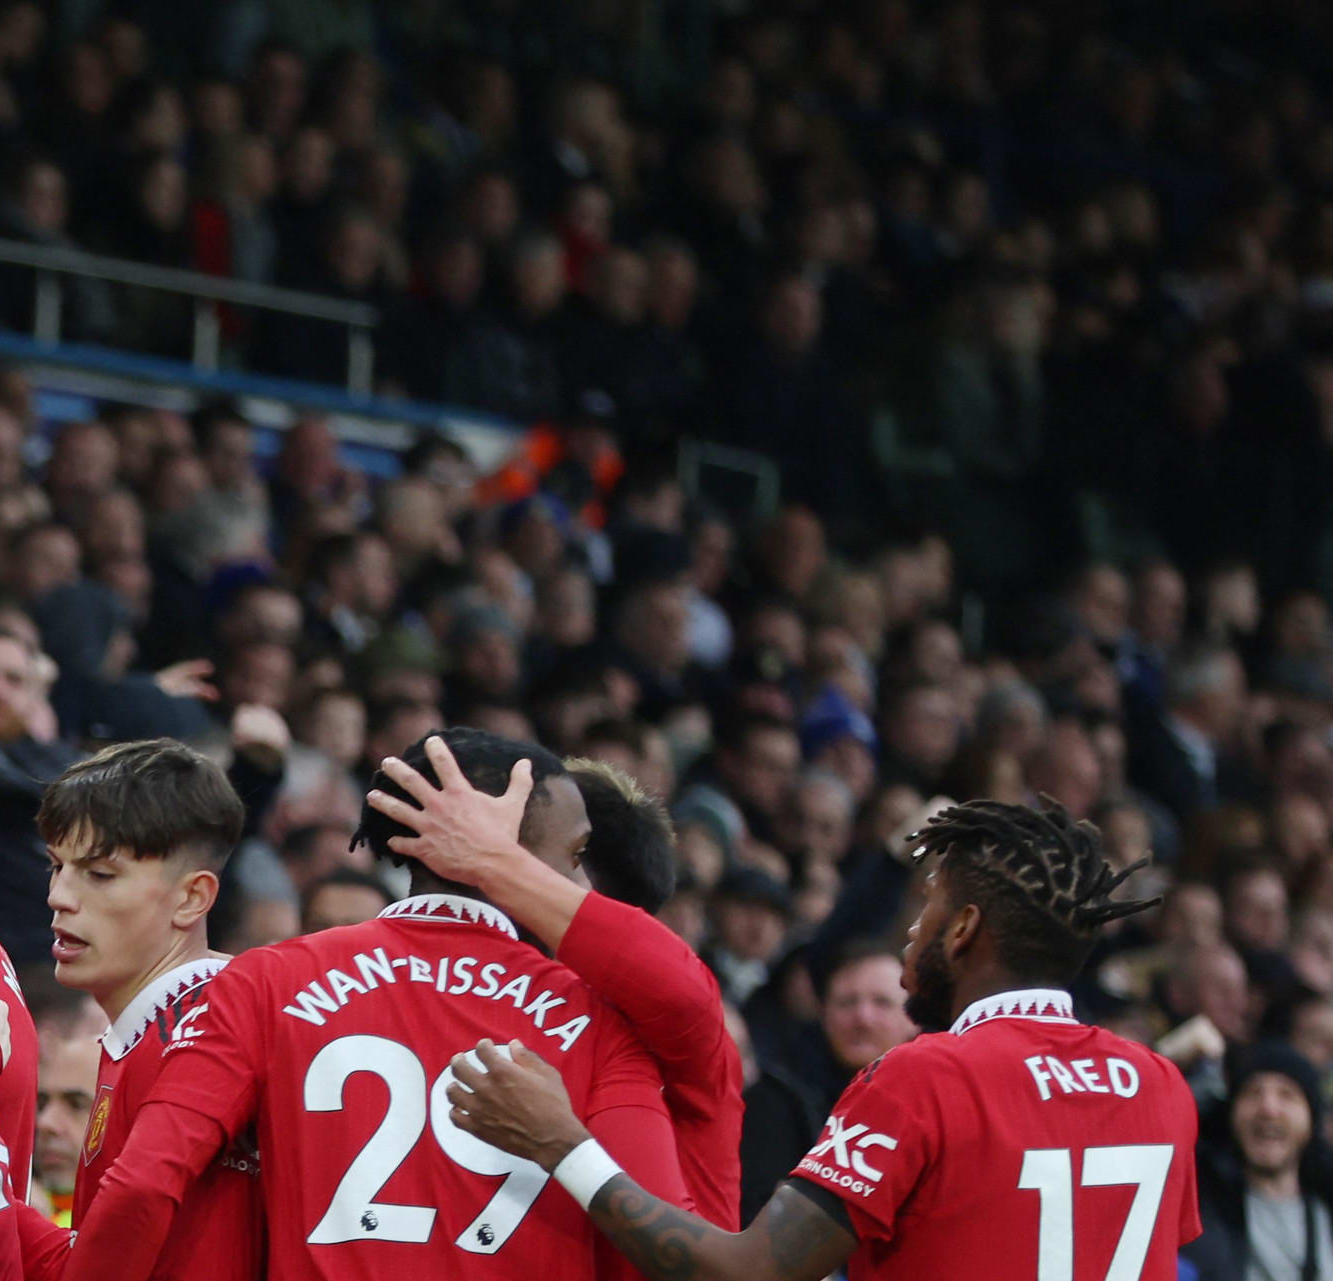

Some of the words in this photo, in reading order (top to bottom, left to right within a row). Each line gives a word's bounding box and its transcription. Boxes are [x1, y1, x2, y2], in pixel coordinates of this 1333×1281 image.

[282, 947, 592, 1052] WAN-BISSAKA
[1023, 1054, 1141, 1101] FRED
[303, 1033, 552, 1256] 29
